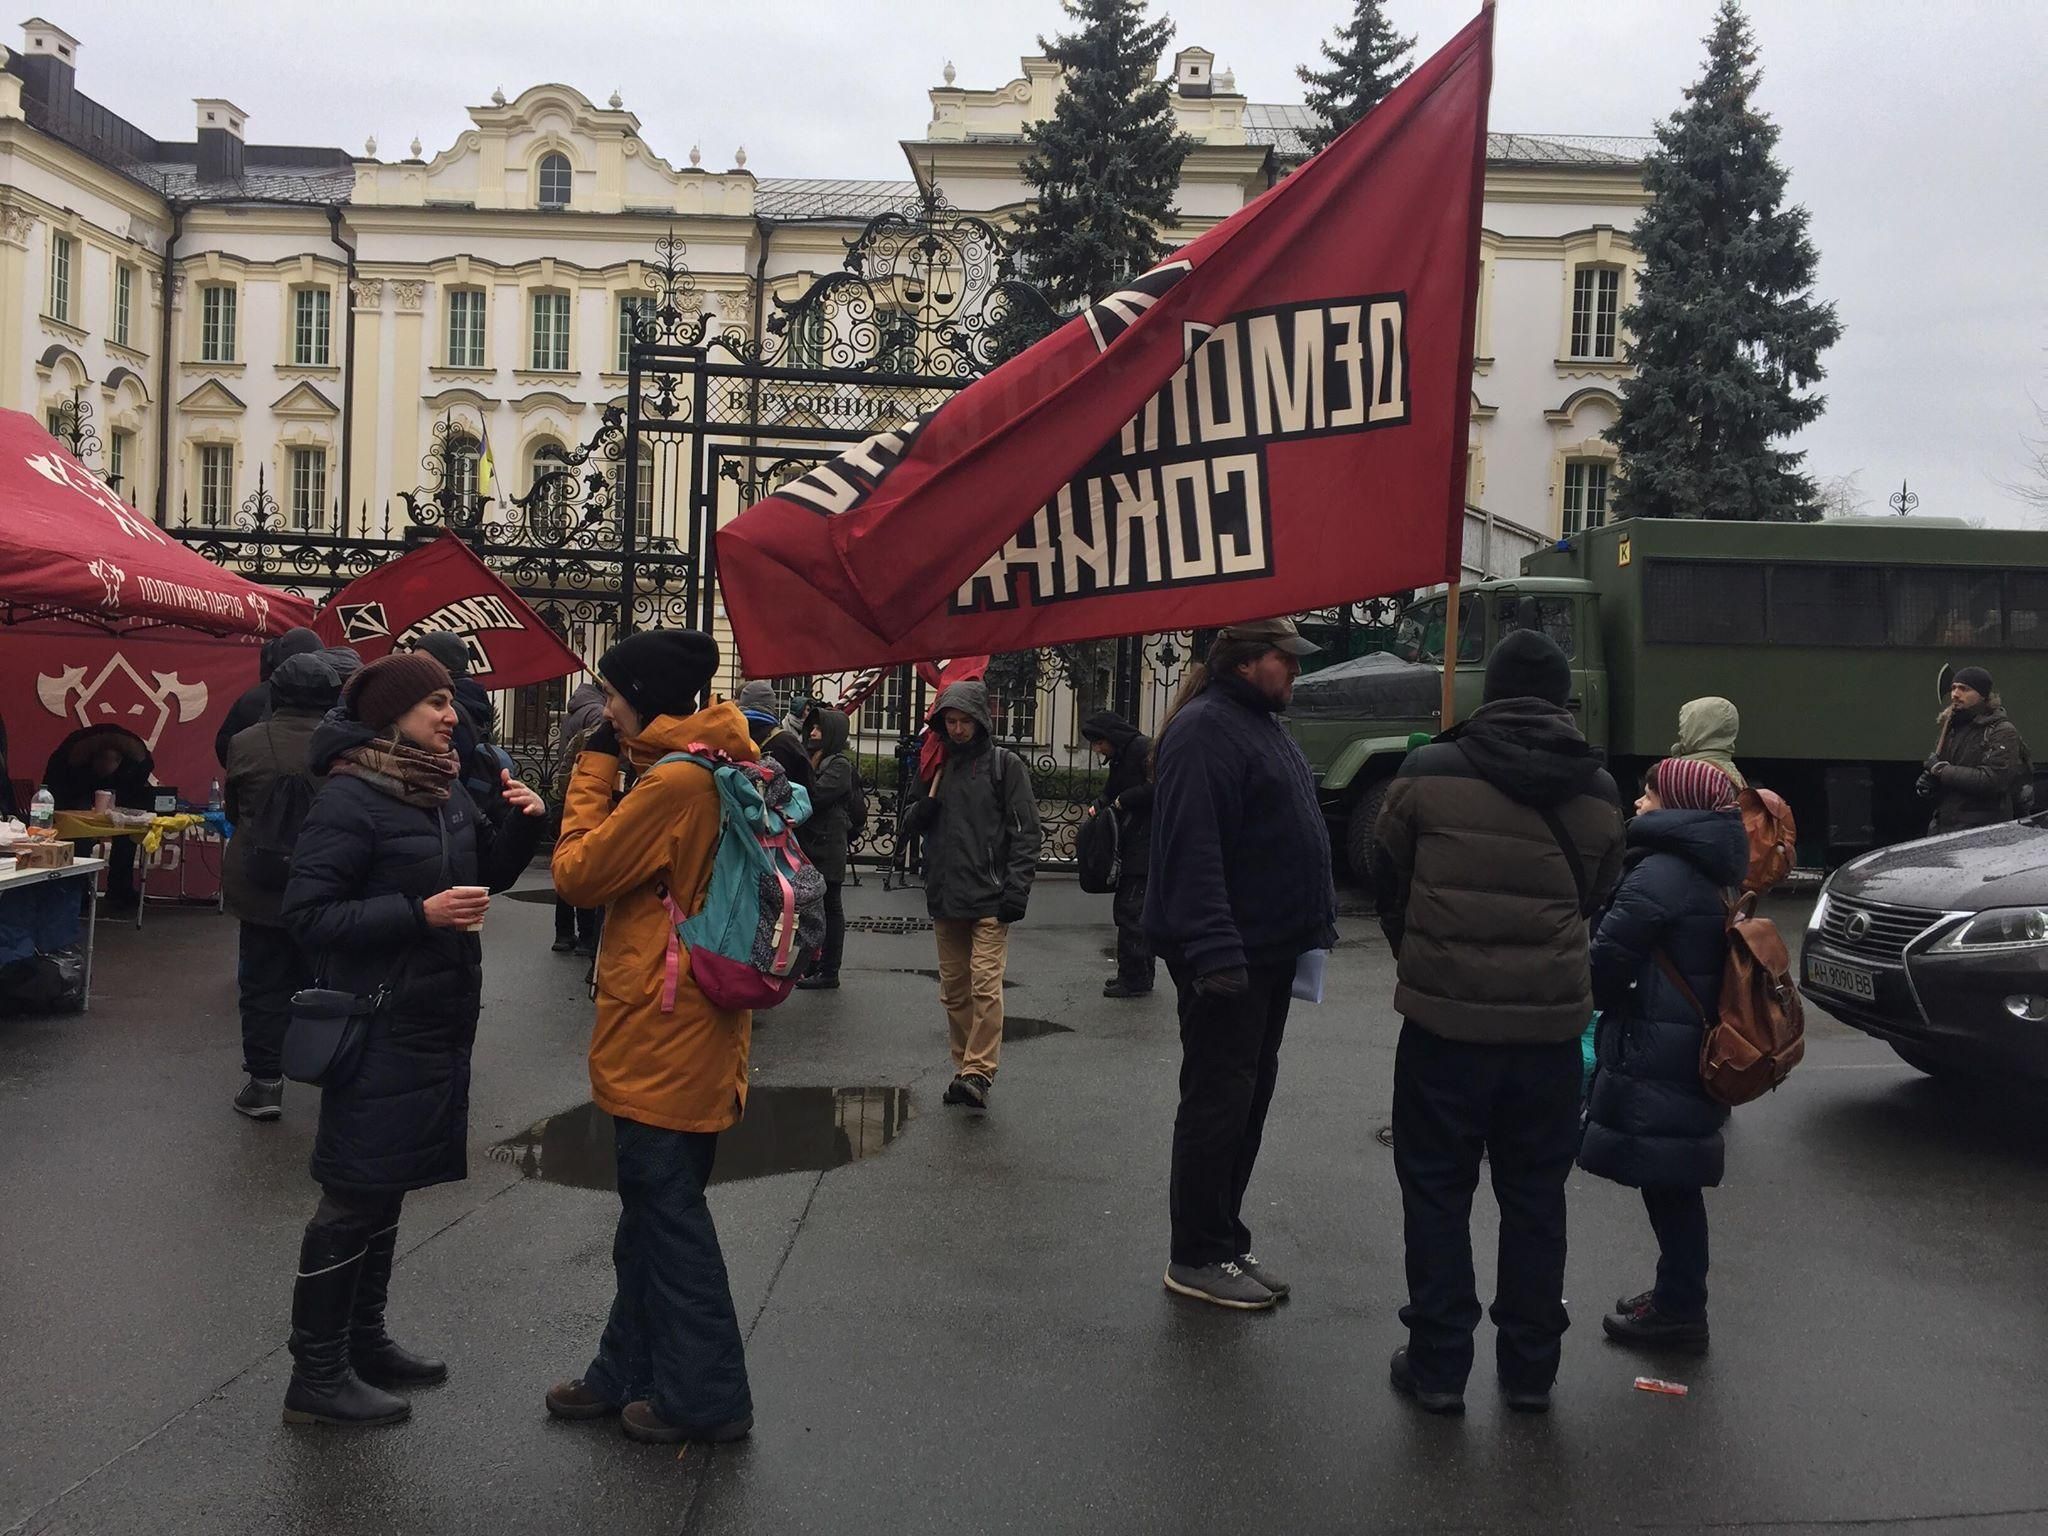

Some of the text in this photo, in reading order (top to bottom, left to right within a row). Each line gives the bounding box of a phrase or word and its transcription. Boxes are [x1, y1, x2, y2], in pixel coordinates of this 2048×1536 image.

[728, 391, 896, 418] ВРХОВНИЙ
[137, 575, 245, 619] ПОЛІТИЧНА ПАРТІЯ
